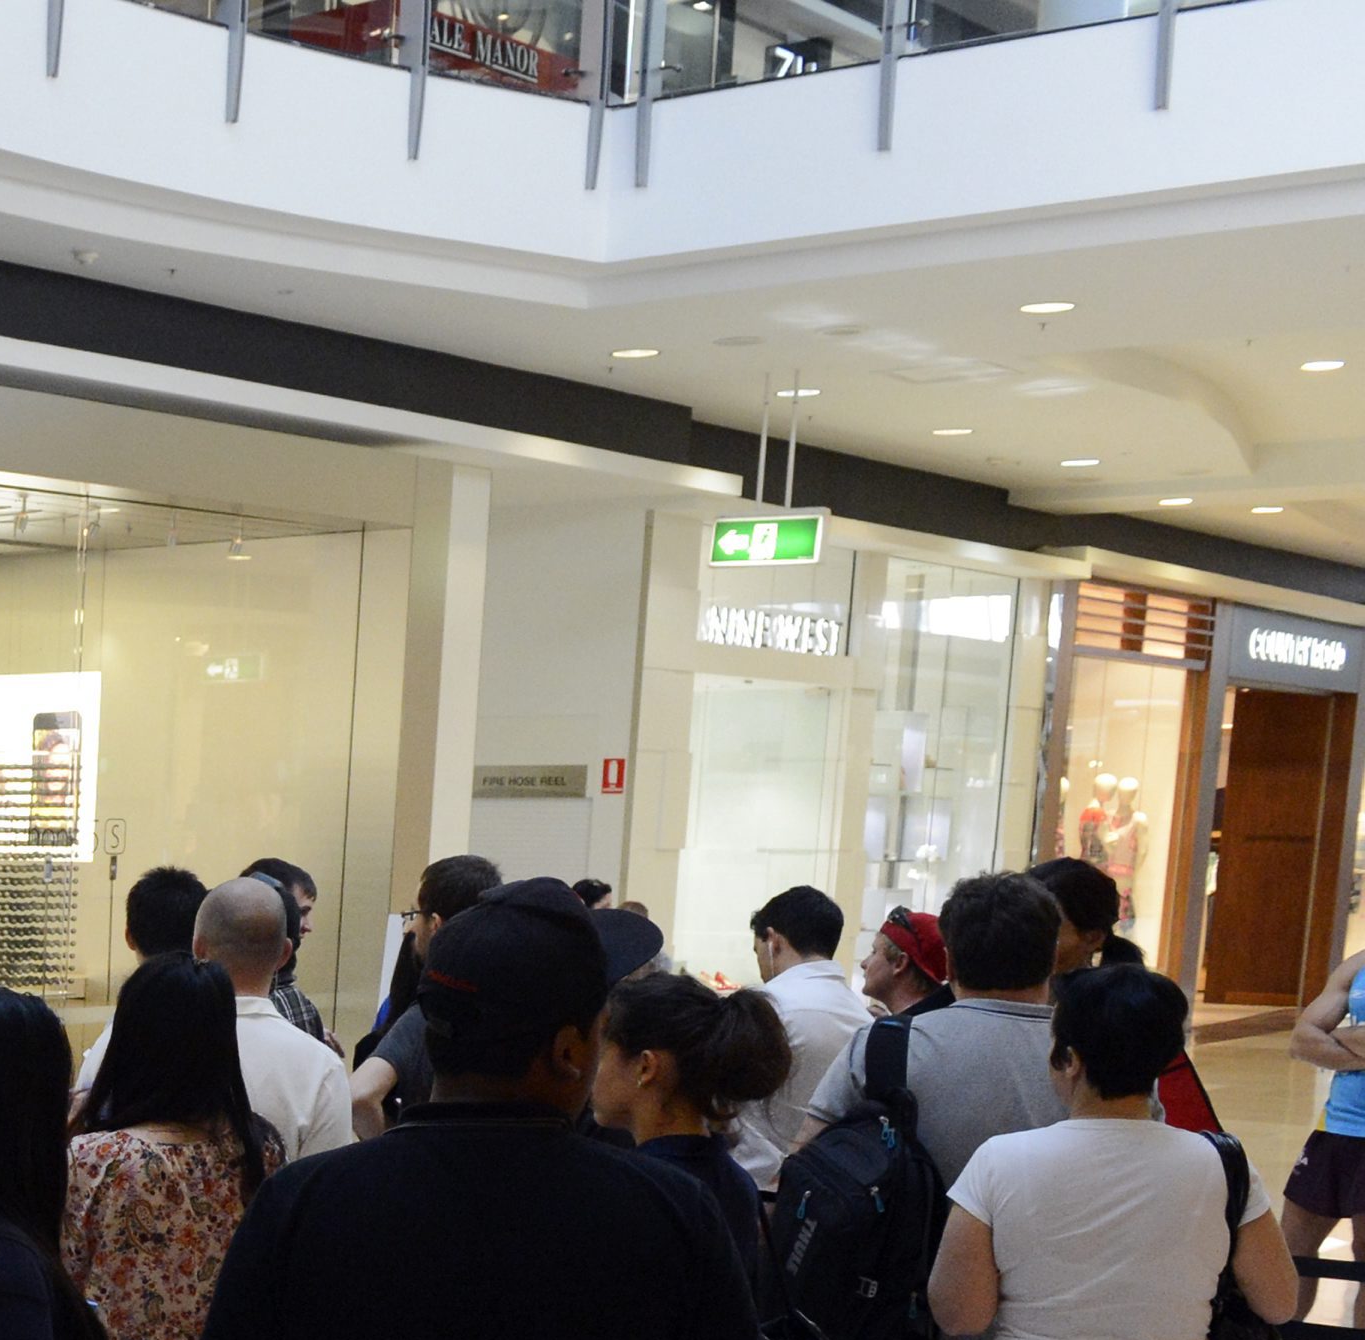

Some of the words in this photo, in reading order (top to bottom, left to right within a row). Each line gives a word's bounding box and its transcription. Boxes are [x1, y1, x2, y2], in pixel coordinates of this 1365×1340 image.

[429, 16, 466, 52] ALE
[475, 29, 539, 77] MANOR
[773, 613, 844, 657] WEST
[482, 776, 506, 786] FIRE
[508, 776, 536, 786] HOSE
[540, 776, 567, 786] REEL
[786, 1217, 818, 1276] THULE
